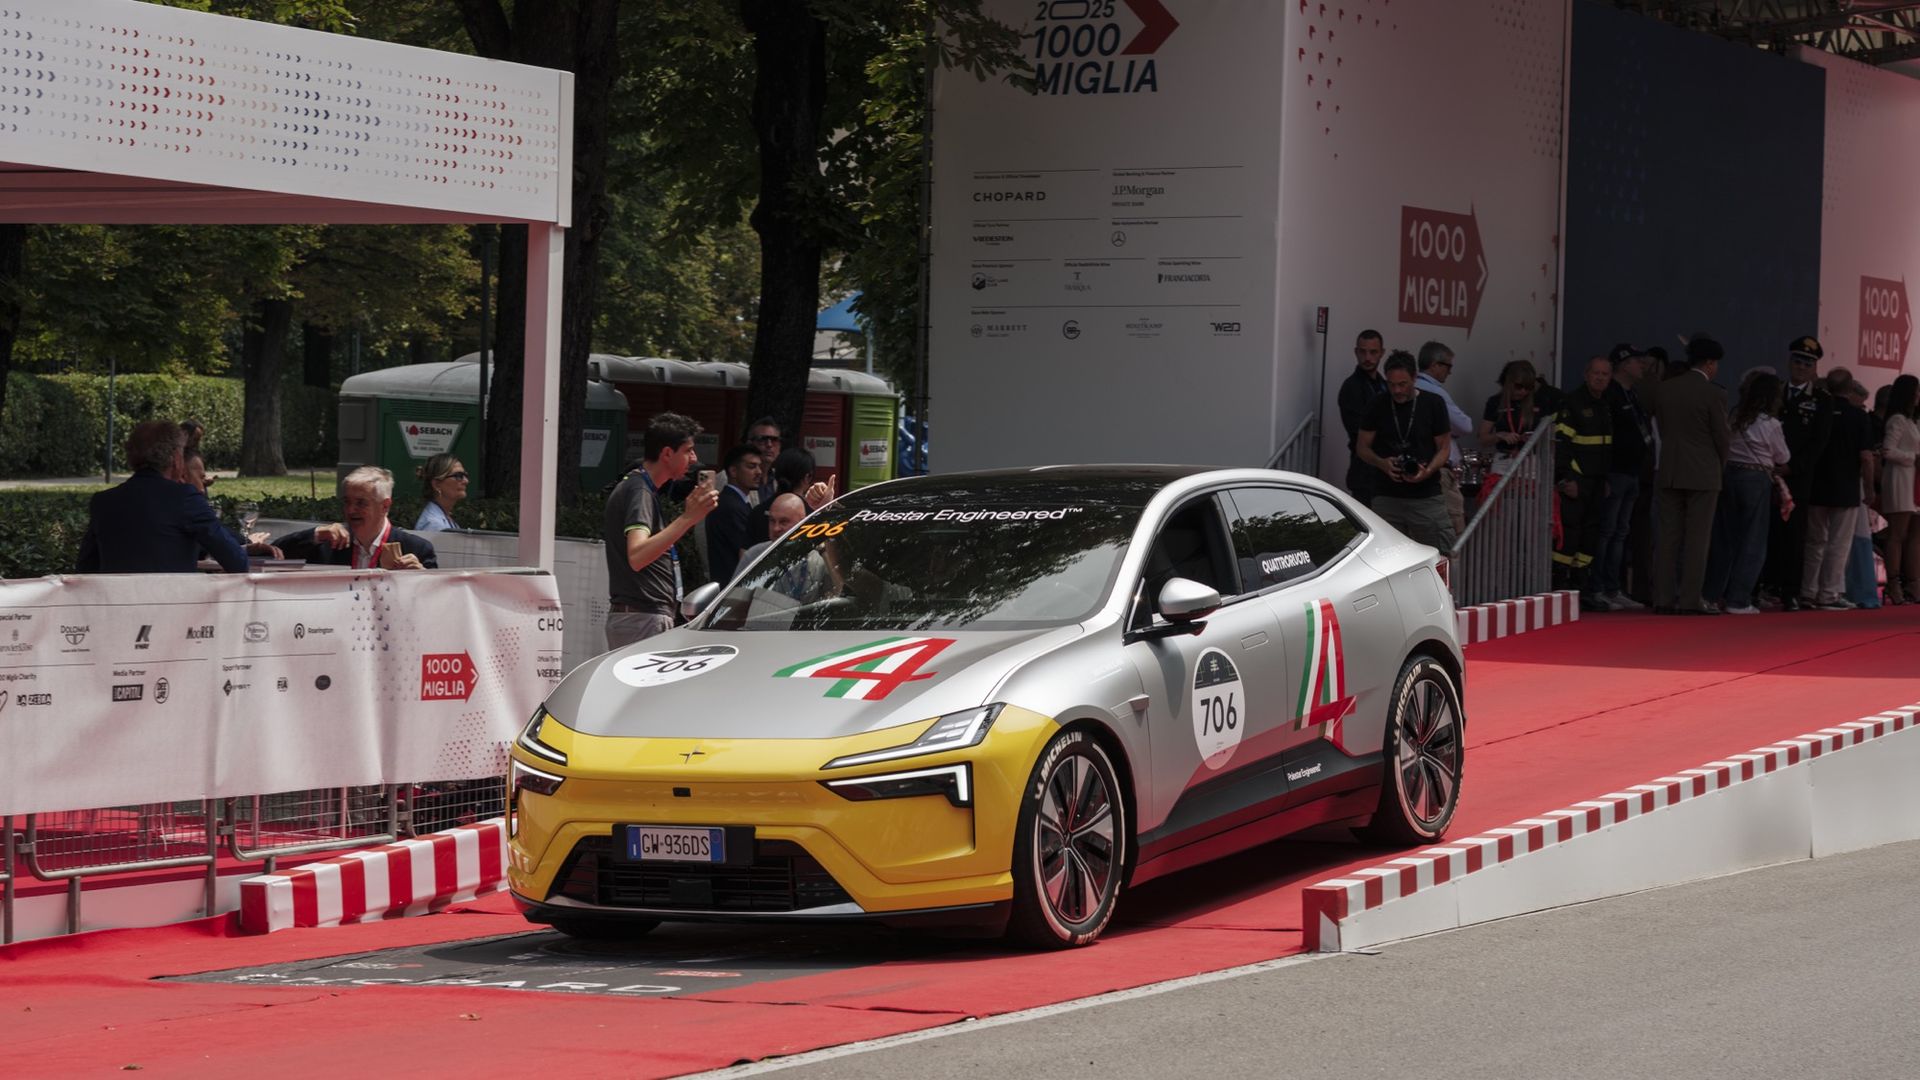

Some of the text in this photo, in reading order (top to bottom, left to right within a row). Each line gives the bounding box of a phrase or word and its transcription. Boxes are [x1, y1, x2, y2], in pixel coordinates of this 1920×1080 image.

[1035, 23, 1121, 58] 1000
[1034, 59, 1157, 95] MIGLIA
[973, 191, 1047, 202] CHOPARD
[1409, 219, 1465, 262] 1000
[1403, 275, 1468, 317] MIGLIA
[1864, 286, 1900, 319] 1000
[1860, 329, 1900, 362] MIGLIA
[419, 426, 453, 435] SEBACH
[849, 509, 934, 522] Polestar
[789, 521, 848, 540] 706
[537, 618, 563, 631] CHO
[425, 658, 463, 674] 1000
[537, 669, 561, 678] VREDE
[632, 657, 714, 673] 706
[422, 680, 466, 697] MIGLIA
[1200, 692, 1237, 736] 706
[1039, 731, 1082, 781] MICHELIN
